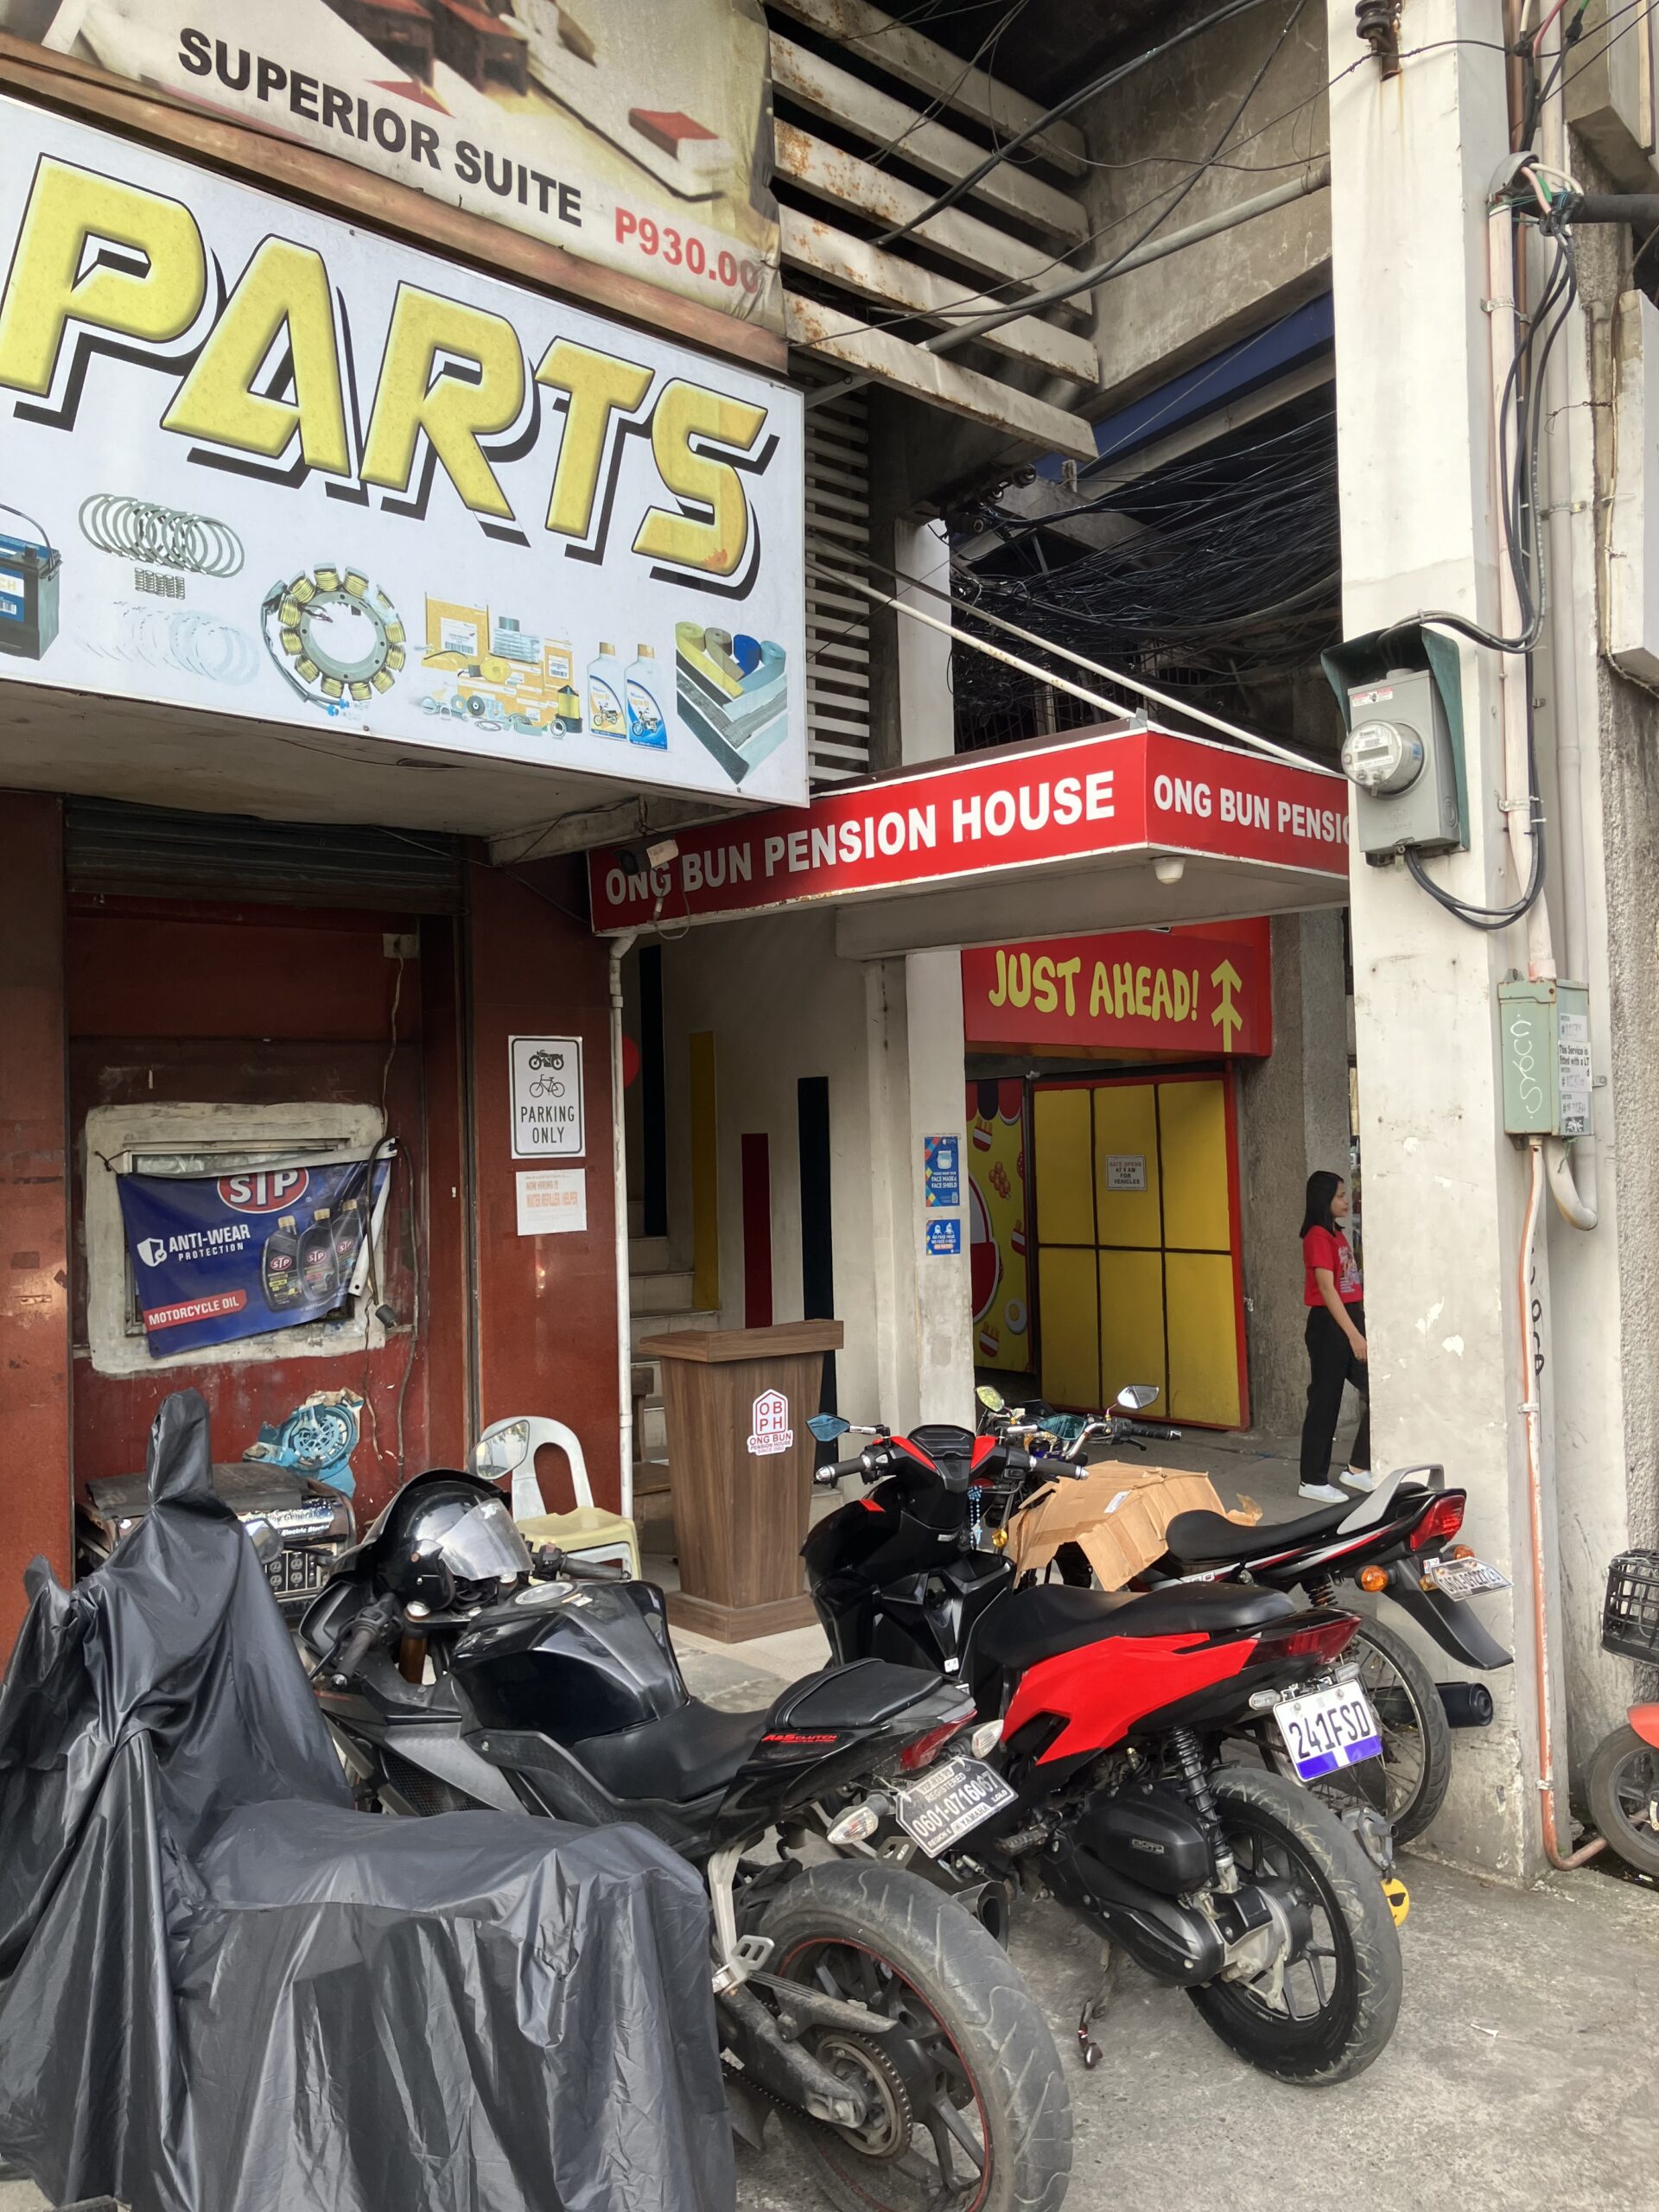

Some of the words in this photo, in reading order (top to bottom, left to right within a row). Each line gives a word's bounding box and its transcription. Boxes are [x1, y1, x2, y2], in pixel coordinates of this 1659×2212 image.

[178, 28, 442, 171] SUPERIOR
[454, 140, 582, 228] SUITE
[615, 206, 759, 294] P930.00
[0, 153, 772, 581] PARTS
[1154, 774, 1212, 818] ONG
[1220, 787, 1270, 830] BUN
[606, 861, 672, 906] ONG
[682, 842, 752, 893] BUN
[764, 804, 937, 877] PENSION
[952, 771, 1116, 842] HOUSE
[988, 950, 1081, 1017] JUST
[1090, 962, 1199, 1022] AHEAD!
[520, 1105, 575, 1123] PARKING
[532, 1126, 564, 1144] ONLY
[229, 1167, 299, 1205] STP
[168, 1224, 251, 1253] ANTI-WEAR
[178, 1242, 244, 1262] PROTECTION
[308, 1250, 324, 1262] STP
[273, 1257, 290, 1268] STP
[148, 1300, 220, 1325] MOTORCYCLE
[222, 1296, 240, 1309] OIL
[749, 1436, 770, 1446] ONG
[772, 1433, 791, 1442] BUN
[1288, 1700, 1370, 1759] 241FSD
[912, 1770, 999, 1838] 0601-0716067
[925, 1772, 966, 1803] REGISTERED
[927, 1829, 949, 1847] REGION
[960, 1803, 989, 1827] YAMAHA
